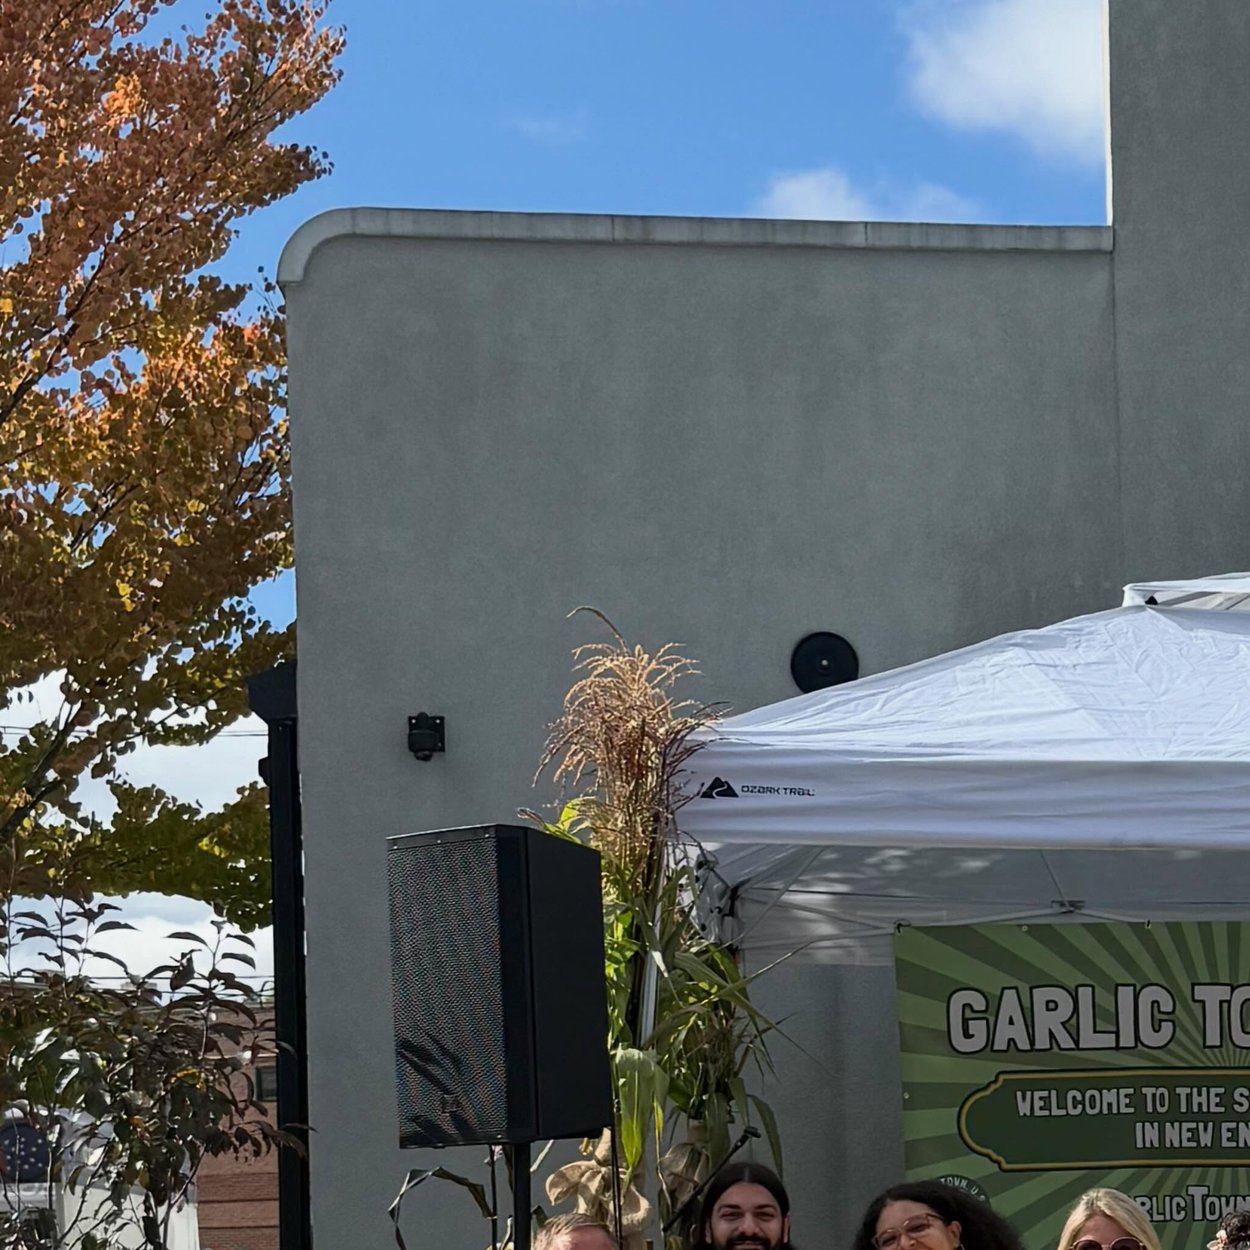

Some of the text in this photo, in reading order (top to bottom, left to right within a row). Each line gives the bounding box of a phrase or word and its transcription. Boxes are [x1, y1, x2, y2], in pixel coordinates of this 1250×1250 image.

[741, 785, 780, 795] OZARK
[948, 985, 1175, 1054] GARLIC
[1016, 1089, 1135, 1117] WELCOME
[1141, 1088, 1170, 1114] TO
[1175, 1087, 1226, 1113] THE
[1135, 1122, 1160, 1149] IN
[1165, 1122, 1214, 1149] NEW
